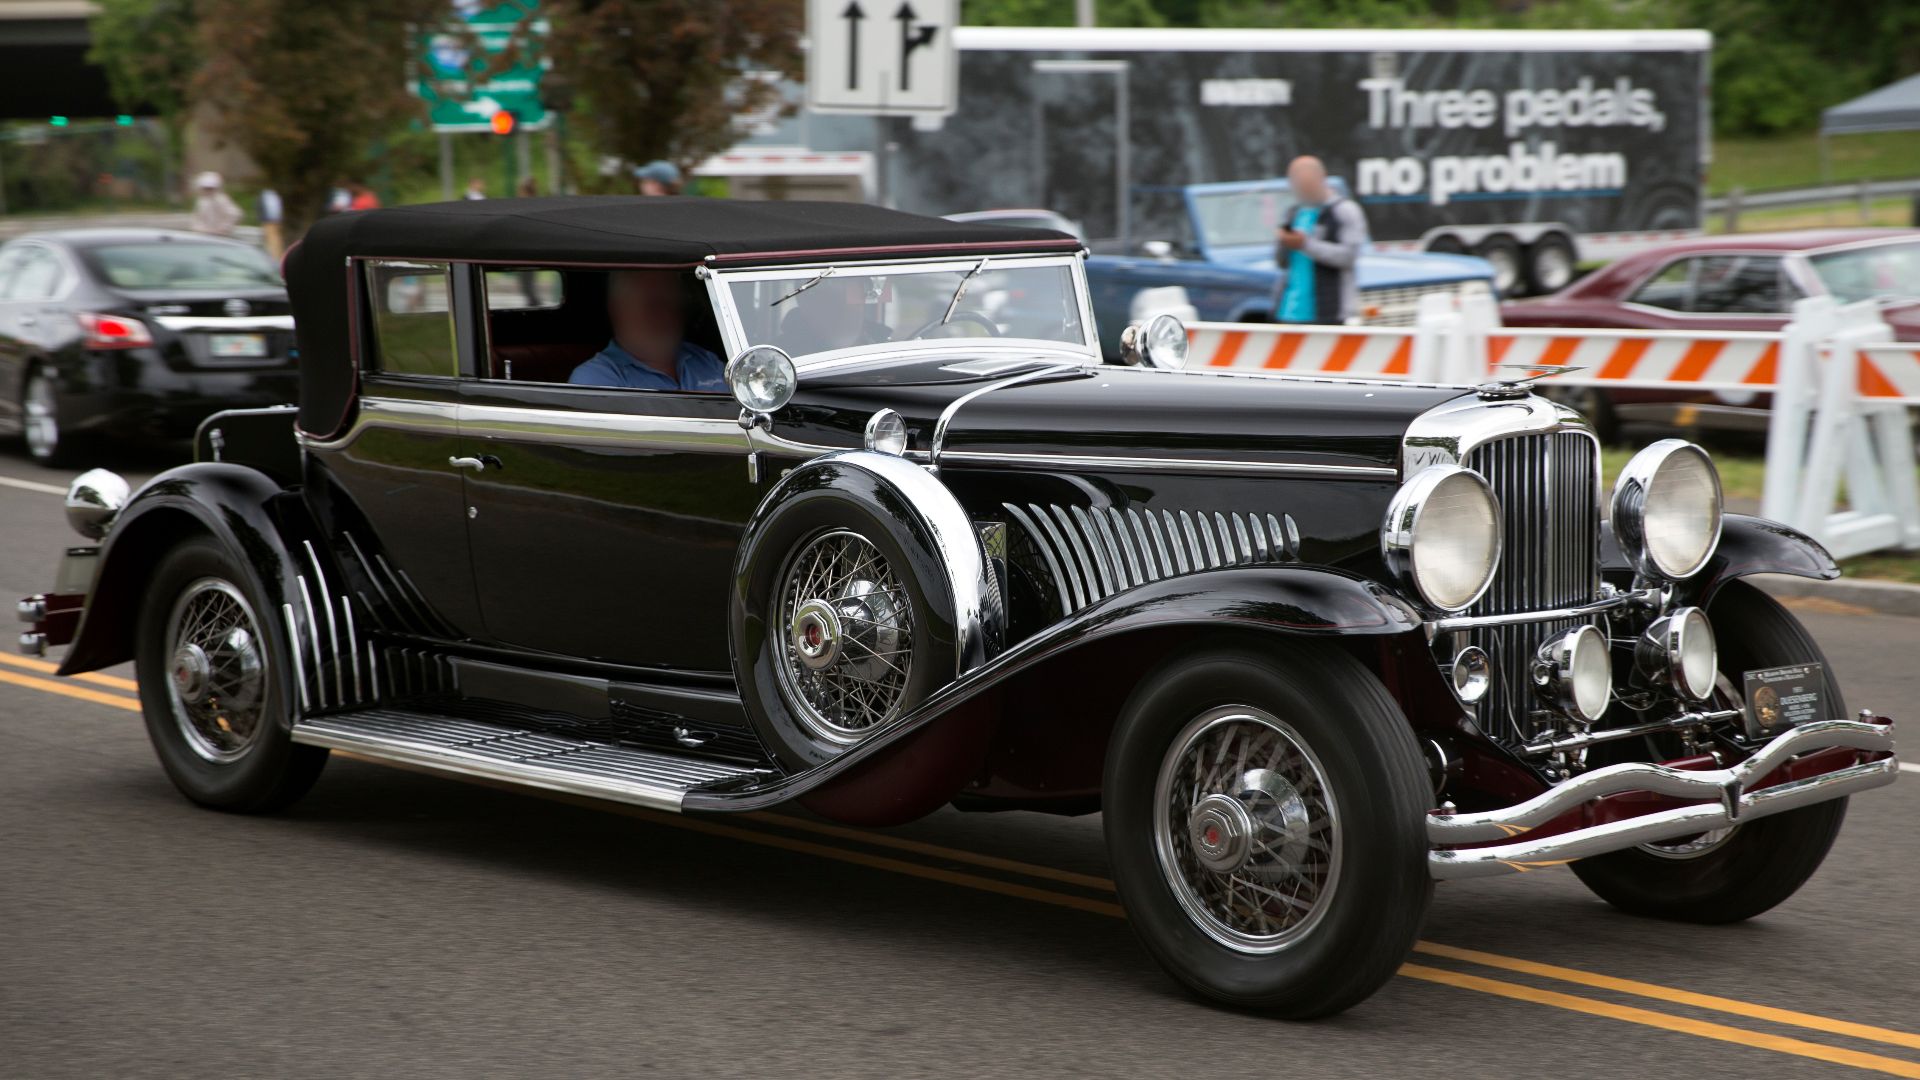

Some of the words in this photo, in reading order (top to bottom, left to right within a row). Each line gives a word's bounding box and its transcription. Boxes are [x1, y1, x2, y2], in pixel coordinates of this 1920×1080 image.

[1359, 78, 1496, 128] Three
[1506, 77, 1666, 136] pedals,
[1358, 157, 1425, 196] no
[1432, 141, 1625, 204] problem
